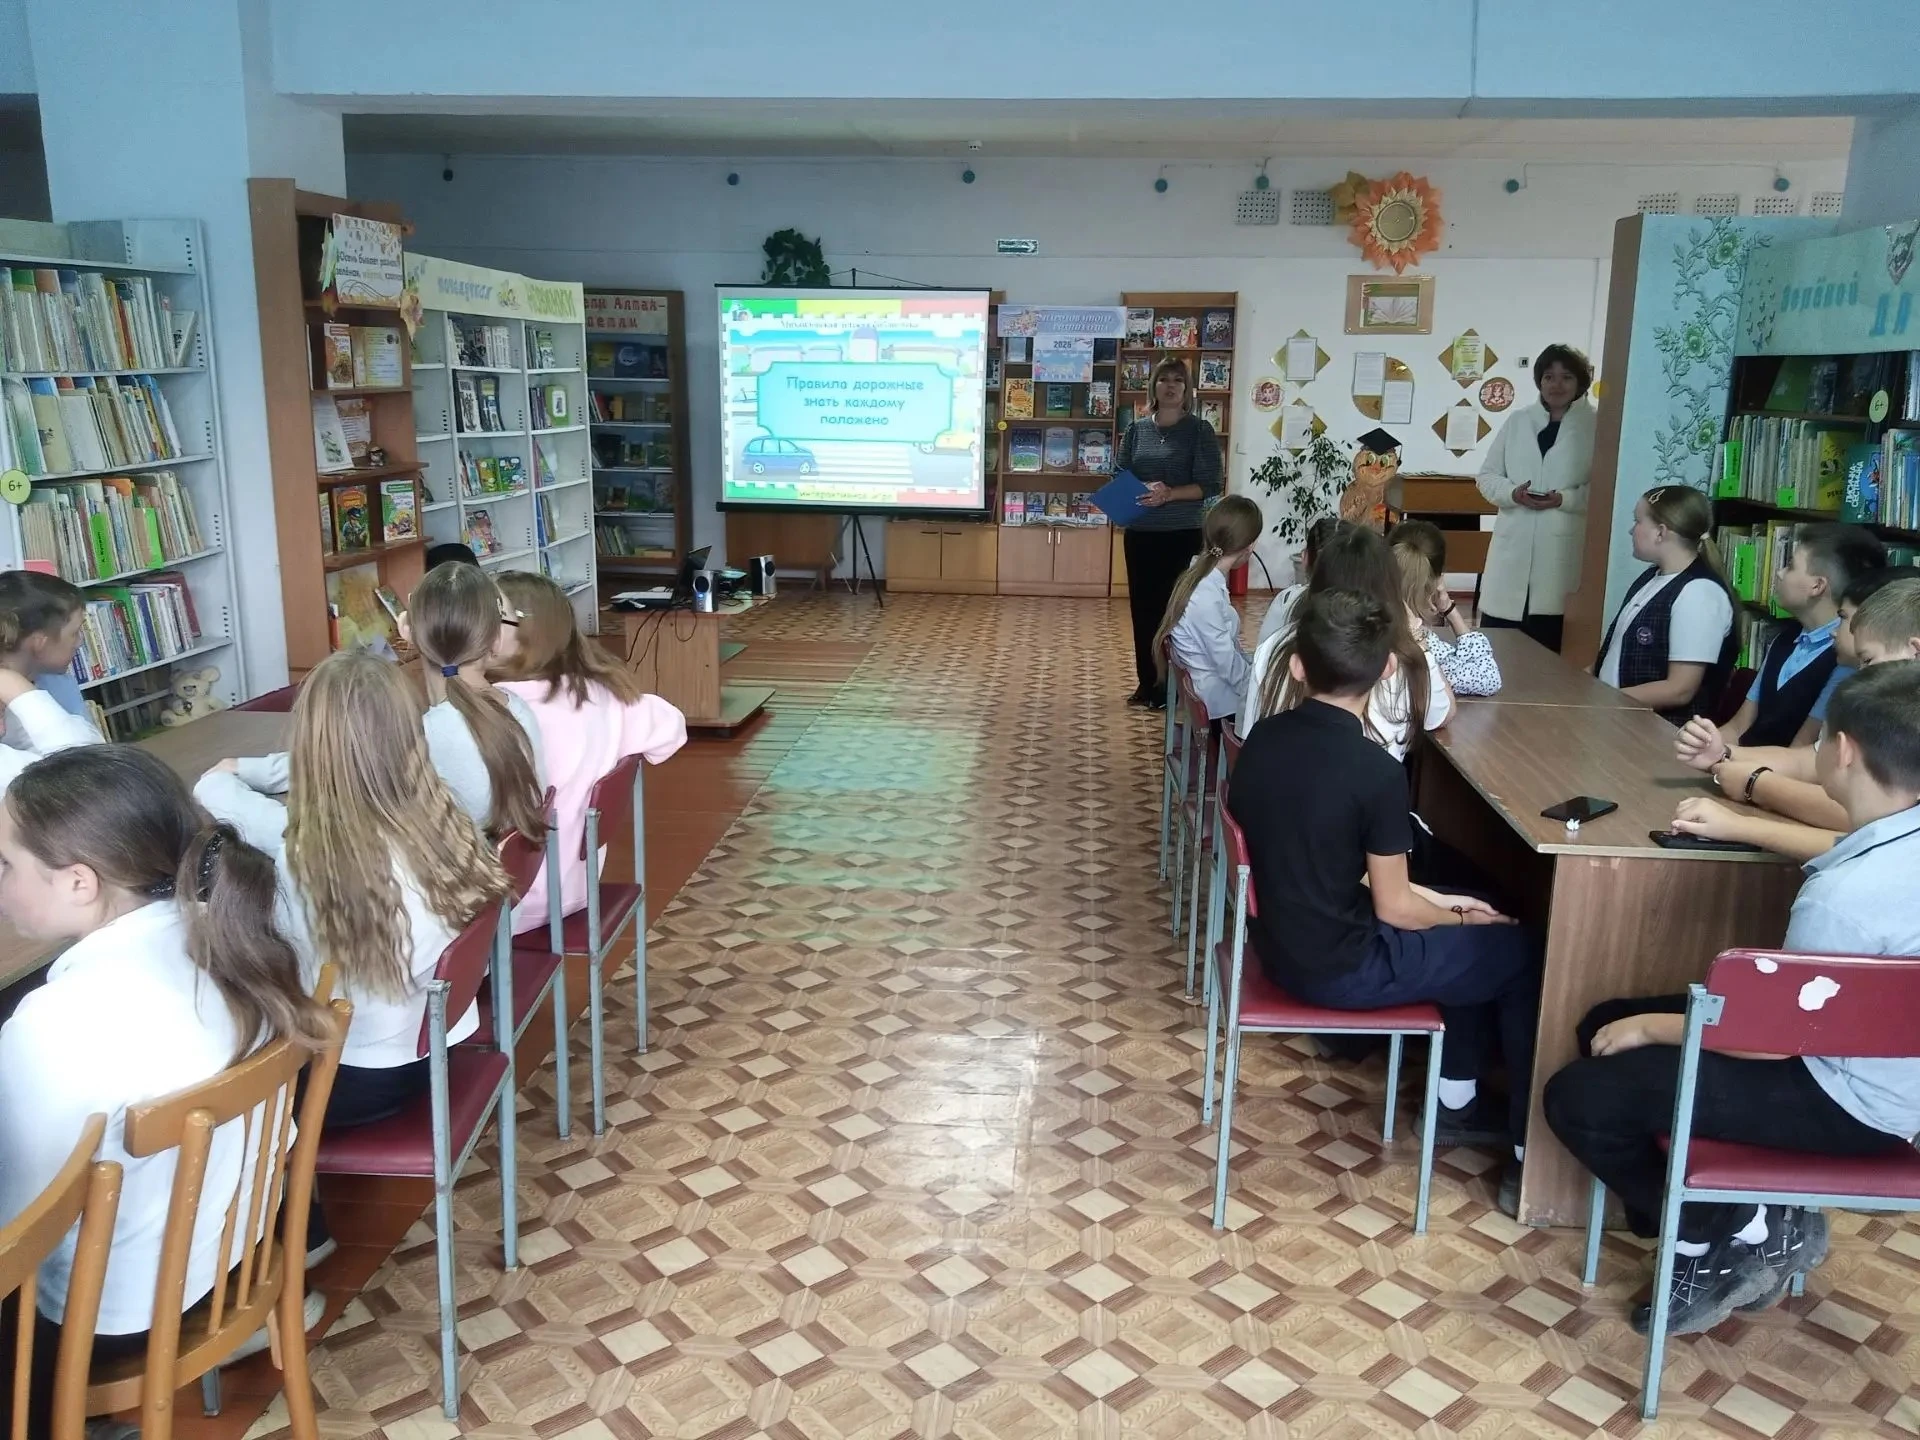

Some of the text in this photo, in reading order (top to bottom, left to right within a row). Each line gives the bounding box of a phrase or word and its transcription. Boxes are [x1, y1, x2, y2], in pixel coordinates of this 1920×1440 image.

[786, 375, 924, 392] Правила дорожные
[803, 397, 906, 410] знать каждому
[820, 415, 889, 426] положено
[7, 479, 23, 493] 6+
